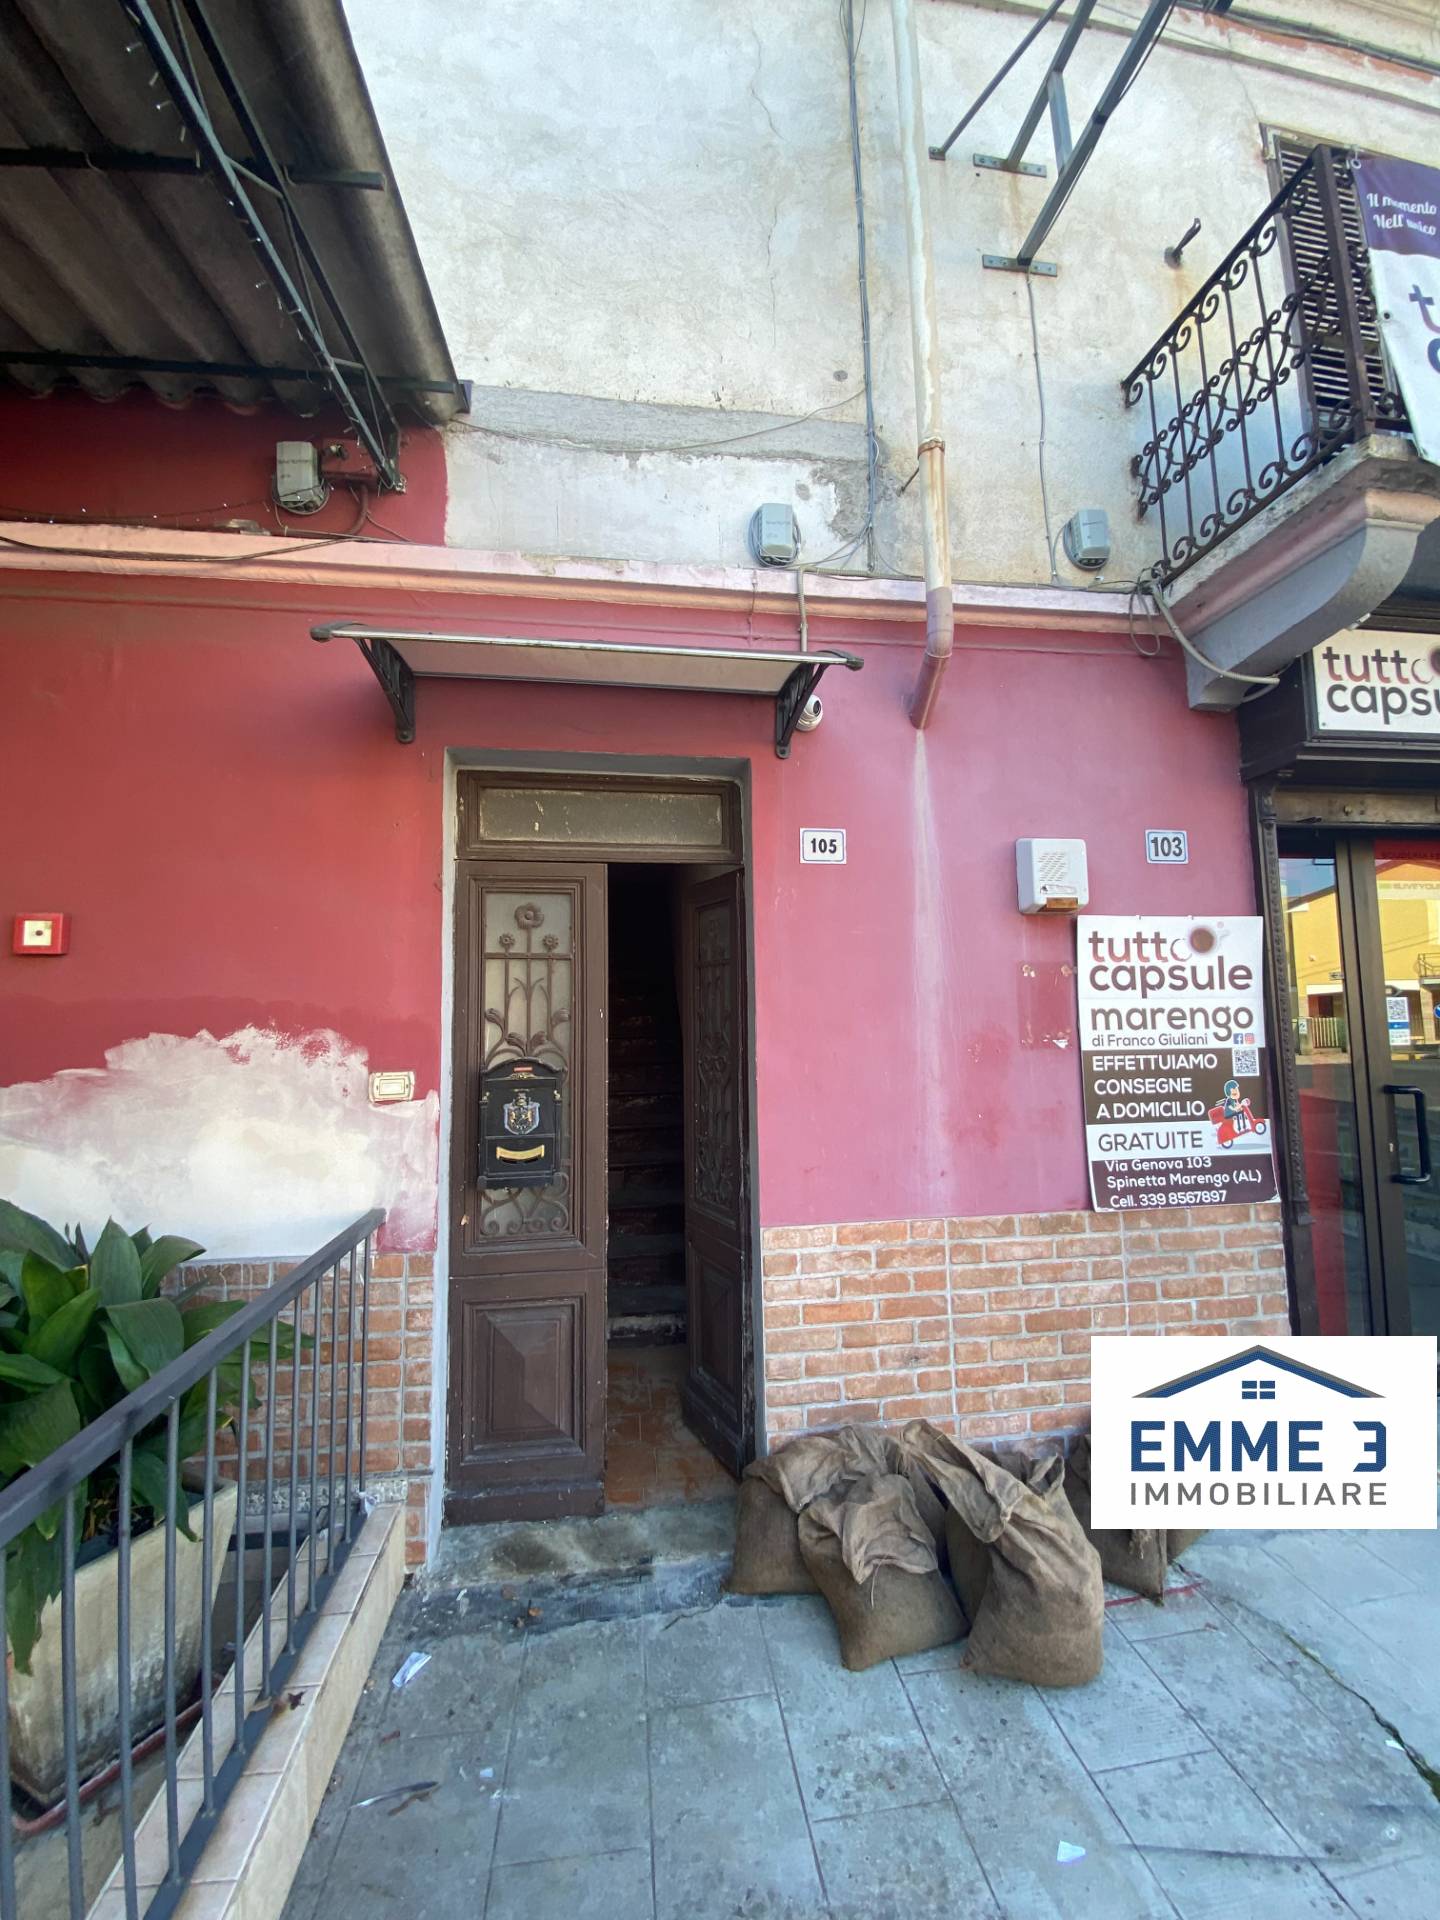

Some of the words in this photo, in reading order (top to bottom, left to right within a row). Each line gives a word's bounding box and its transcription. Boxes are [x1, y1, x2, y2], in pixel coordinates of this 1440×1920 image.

[1366, 193, 1379, 208] Il
[810, 837, 837, 854] 105
[1150, 836, 1183, 857] 103
[1089, 955, 1253, 999] capsule
[1090, 1005, 1254, 1041] marengo
[1092, 1034, 1104, 1047] di
[1109, 1033, 1155, 1047] Franco
[1158, 1032, 1208, 1046] Giuliani
[1092, 1053, 1217, 1071] EFFETTUIAMO
[1094, 1077, 1192, 1095] CONSEGNE
[1096, 1103, 1111, 1119] A
[1113, 1100, 1205, 1118] DOMICILIO
[1098, 1130, 1204, 1152] GRATUITE
[1105, 1160, 1128, 1172] Via
[1132, 1158, 1183, 1171] Genova
[1186, 1156, 1212, 1169] 103
[1107, 1174, 1166, 1191] Spinetta
[1169, 1172, 1229, 1188] Marengo
[1232, 1169, 1262, 1184] (AL)
[1110, 1194, 1137, 1208] Cell.
[1139, 1192, 1166, 1207] 339
[1168, 1189, 1227, 1205] 8567897
